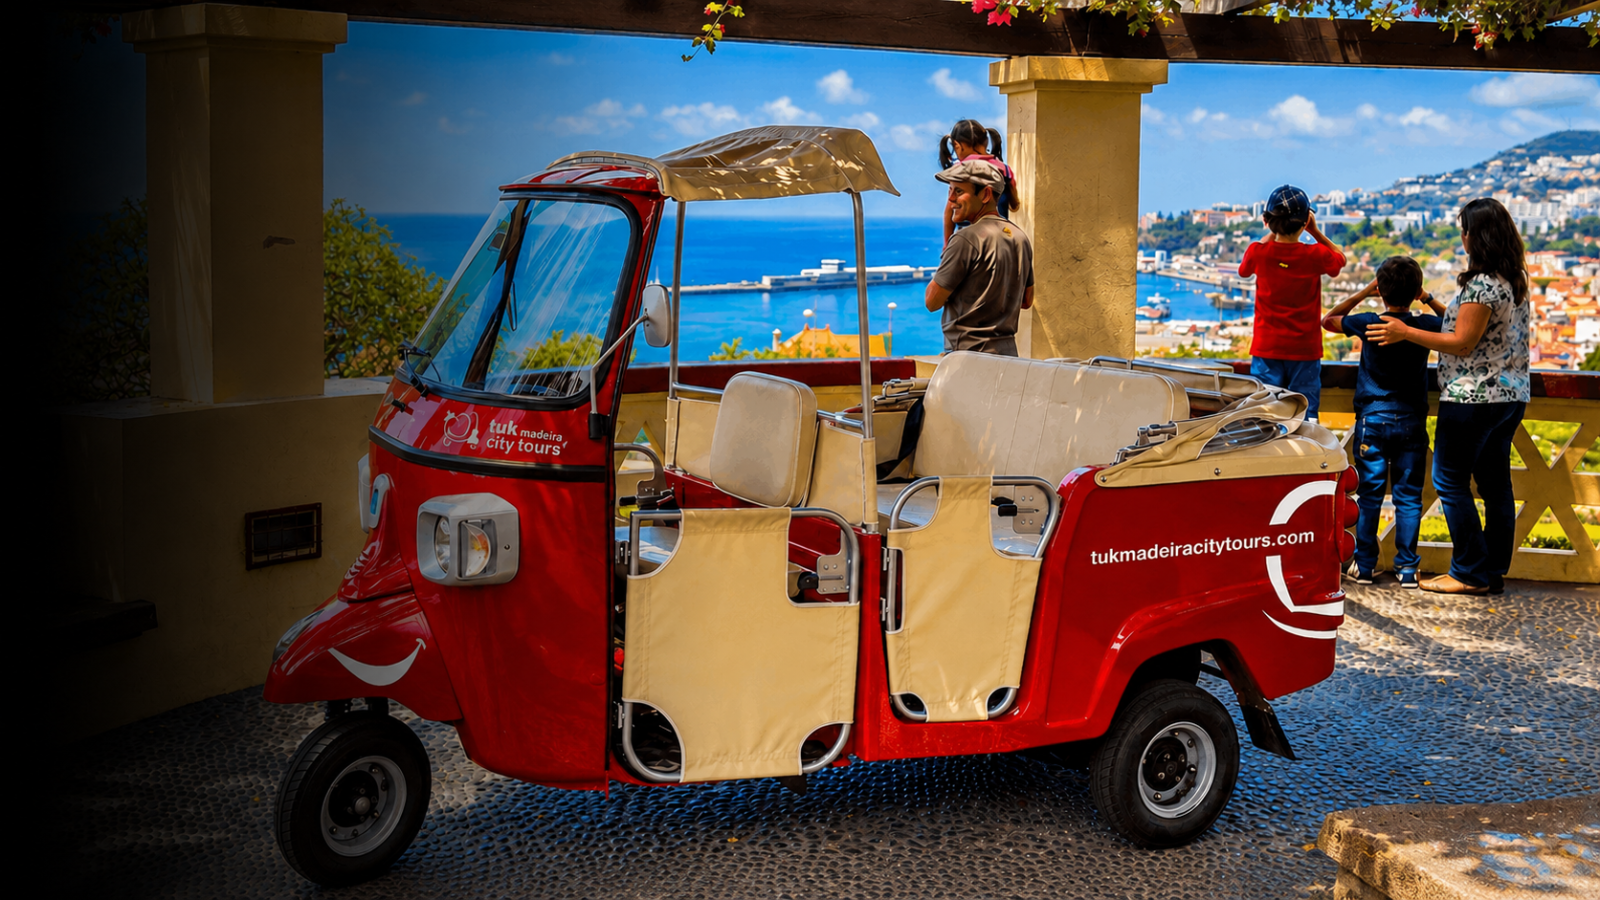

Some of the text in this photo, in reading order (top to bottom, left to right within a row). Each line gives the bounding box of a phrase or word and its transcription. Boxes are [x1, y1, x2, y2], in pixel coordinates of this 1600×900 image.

[489, 419, 563, 442] tuk madeira
[486, 436, 561, 456] city tours
[1090, 531, 1315, 565] tukmadeiracitytours.com
